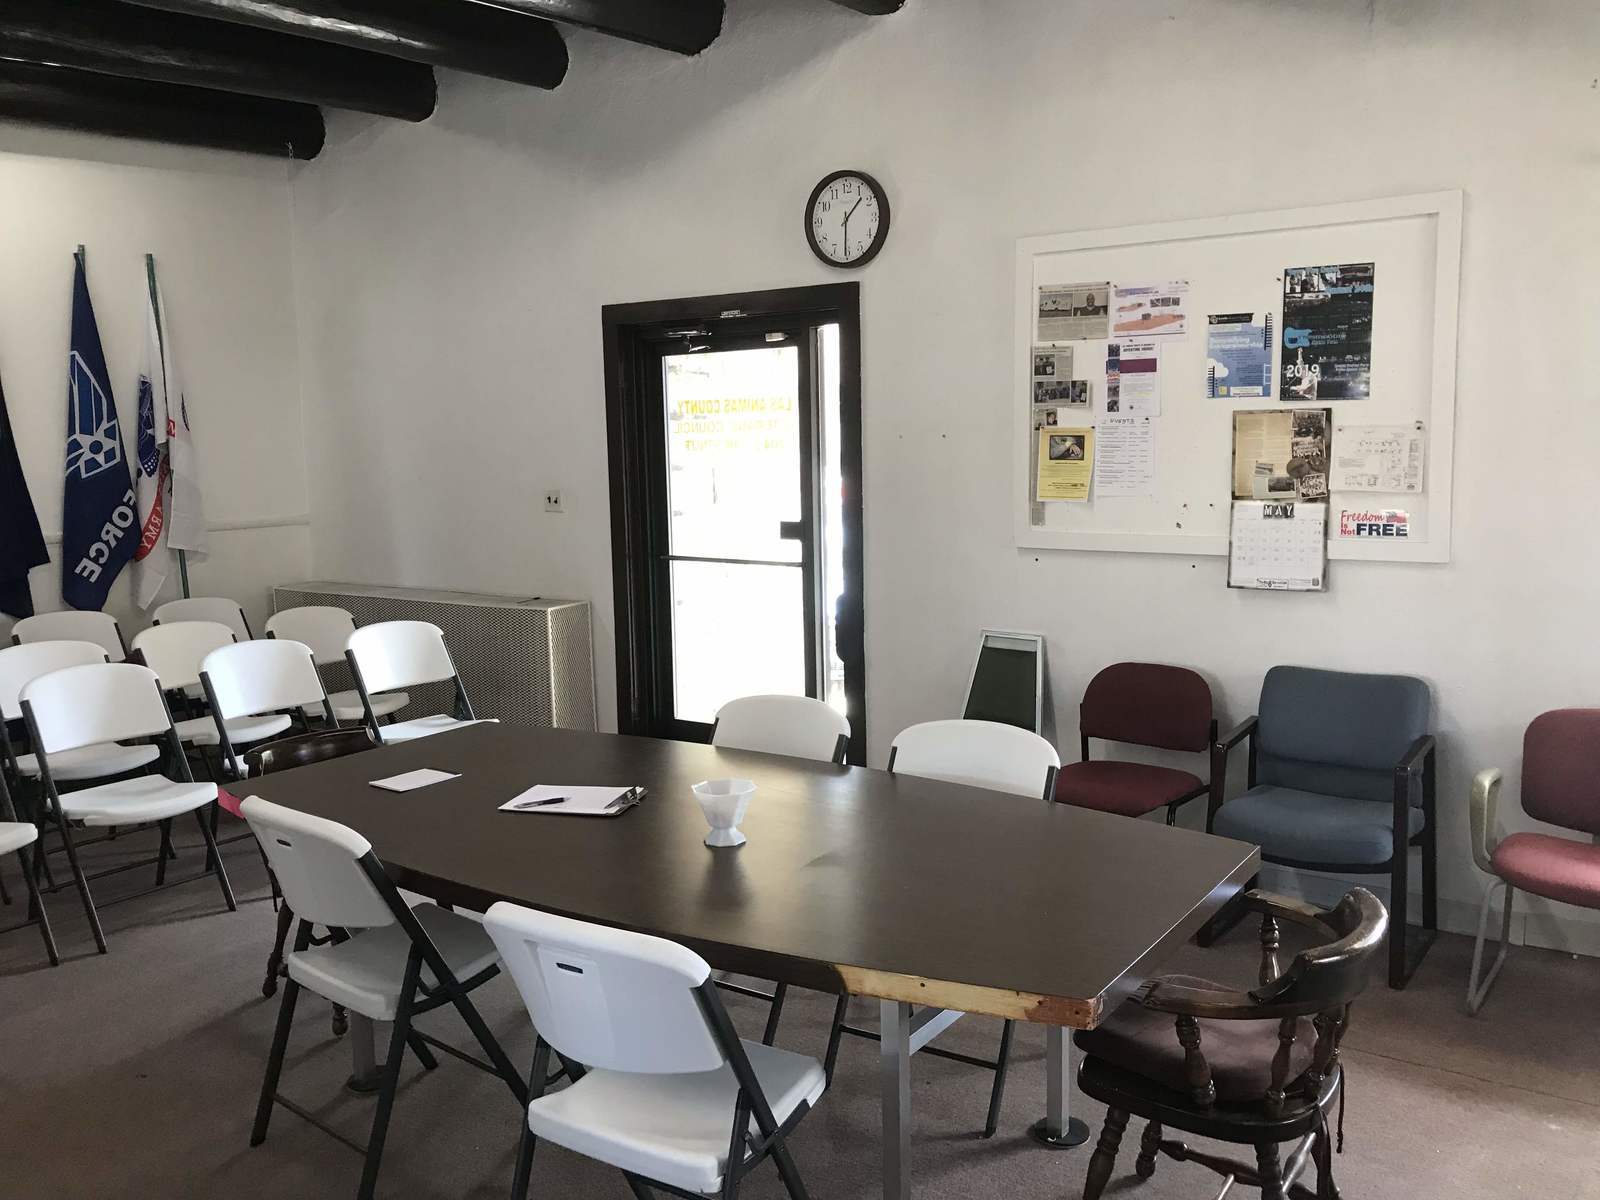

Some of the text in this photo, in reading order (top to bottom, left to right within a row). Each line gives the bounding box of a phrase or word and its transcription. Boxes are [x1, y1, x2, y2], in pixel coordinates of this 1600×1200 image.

[842, 182, 852, 194] 12
[831, 189, 839, 200] 11
[822, 201, 831, 213] 10
[866, 195, 873, 207] 2
[816, 217, 823, 228] 9
[871, 212, 878, 223] 3
[866, 228, 872, 239] 4
[831, 243, 838, 255] 7
[857, 240, 864, 252] 5
[1286, 364, 1319, 377] 2019
[1264, 505, 1292, 516] MAY
[1340, 510, 1385, 522] Freedom
[1356, 523, 1408, 536] FREE
